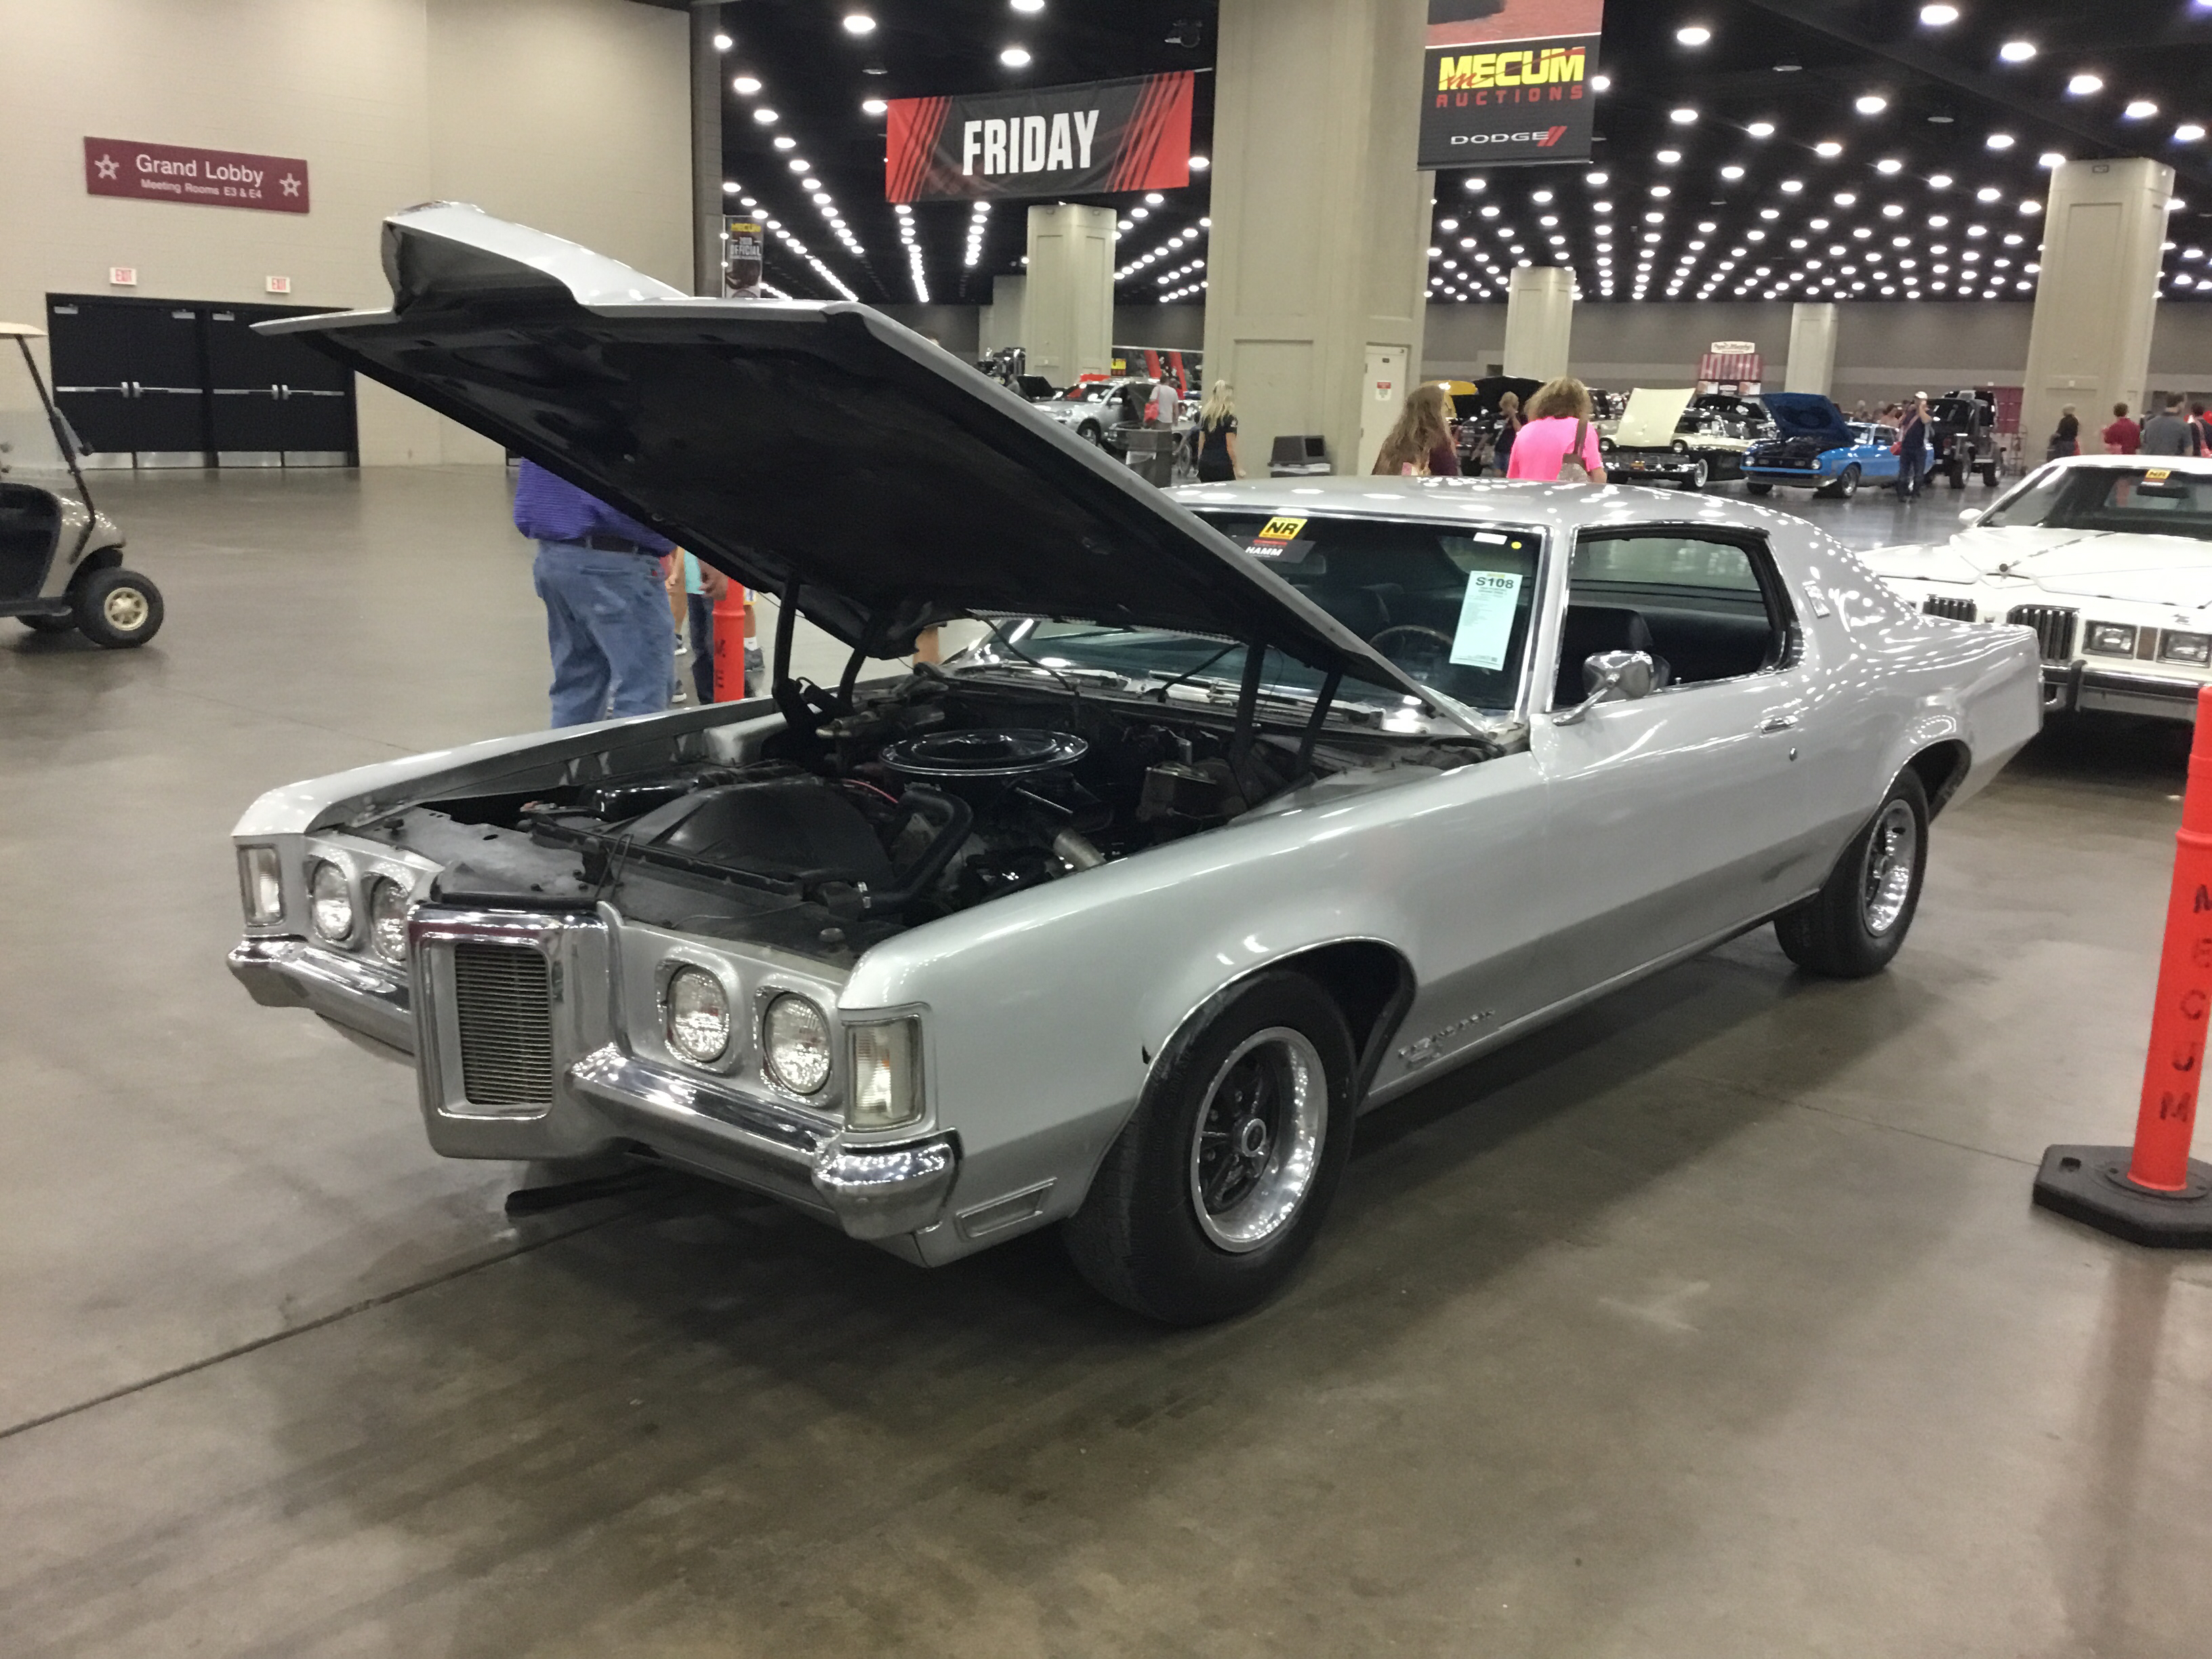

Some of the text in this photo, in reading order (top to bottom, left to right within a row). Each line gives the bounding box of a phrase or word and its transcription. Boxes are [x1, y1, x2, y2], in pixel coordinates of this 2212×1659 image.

[1437, 46, 1586, 91] MECUM
[1435, 85, 1583, 108] AUCTIONS
[962, 110, 1100, 176] FRIDAY
[1450, 131, 1550, 145] DODGE
[136, 154, 264, 187] Grand Lobby
[140, 178, 262, 199] Meeting Rooms E3 & E4
[1265, 522, 1299, 535] NR
[1245, 546, 1283, 556] HAMM
[1475, 577, 1514, 589] S108
